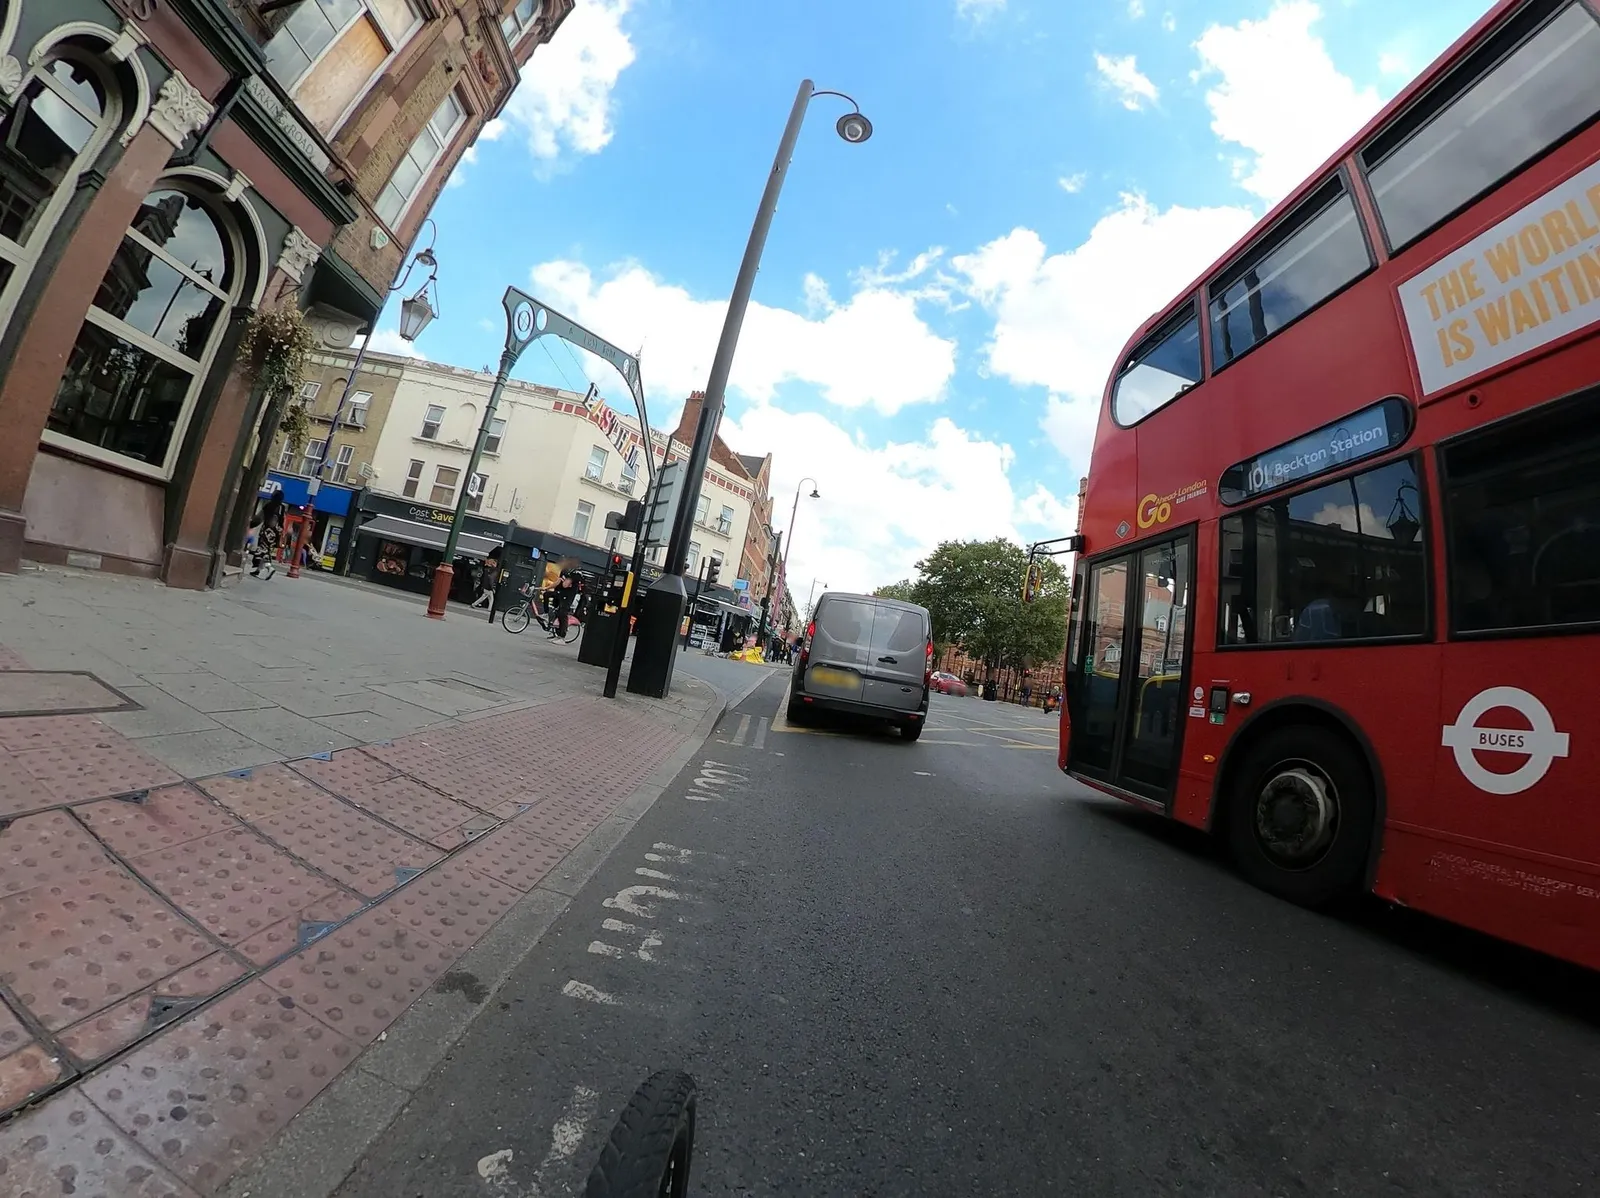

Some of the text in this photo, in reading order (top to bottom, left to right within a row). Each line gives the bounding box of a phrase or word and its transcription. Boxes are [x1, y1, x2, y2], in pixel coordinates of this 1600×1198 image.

[287, 123, 314, 155] ROAD
[1420, 258, 1485, 321] THE
[1436, 317, 1475, 368] IS
[672, 440, 691, 453] ROAD
[1248, 426, 1383, 490] 101 Beckton Station
[1178, 479, 1207, 496] London
[409, 506, 430, 518] Cost
[431, 509, 455, 524] Save
[1137, 493, 1171, 529] Go
[1479, 732, 1525, 748] BUSES
[1515, 870, 1575, 891] TRANSPORT
